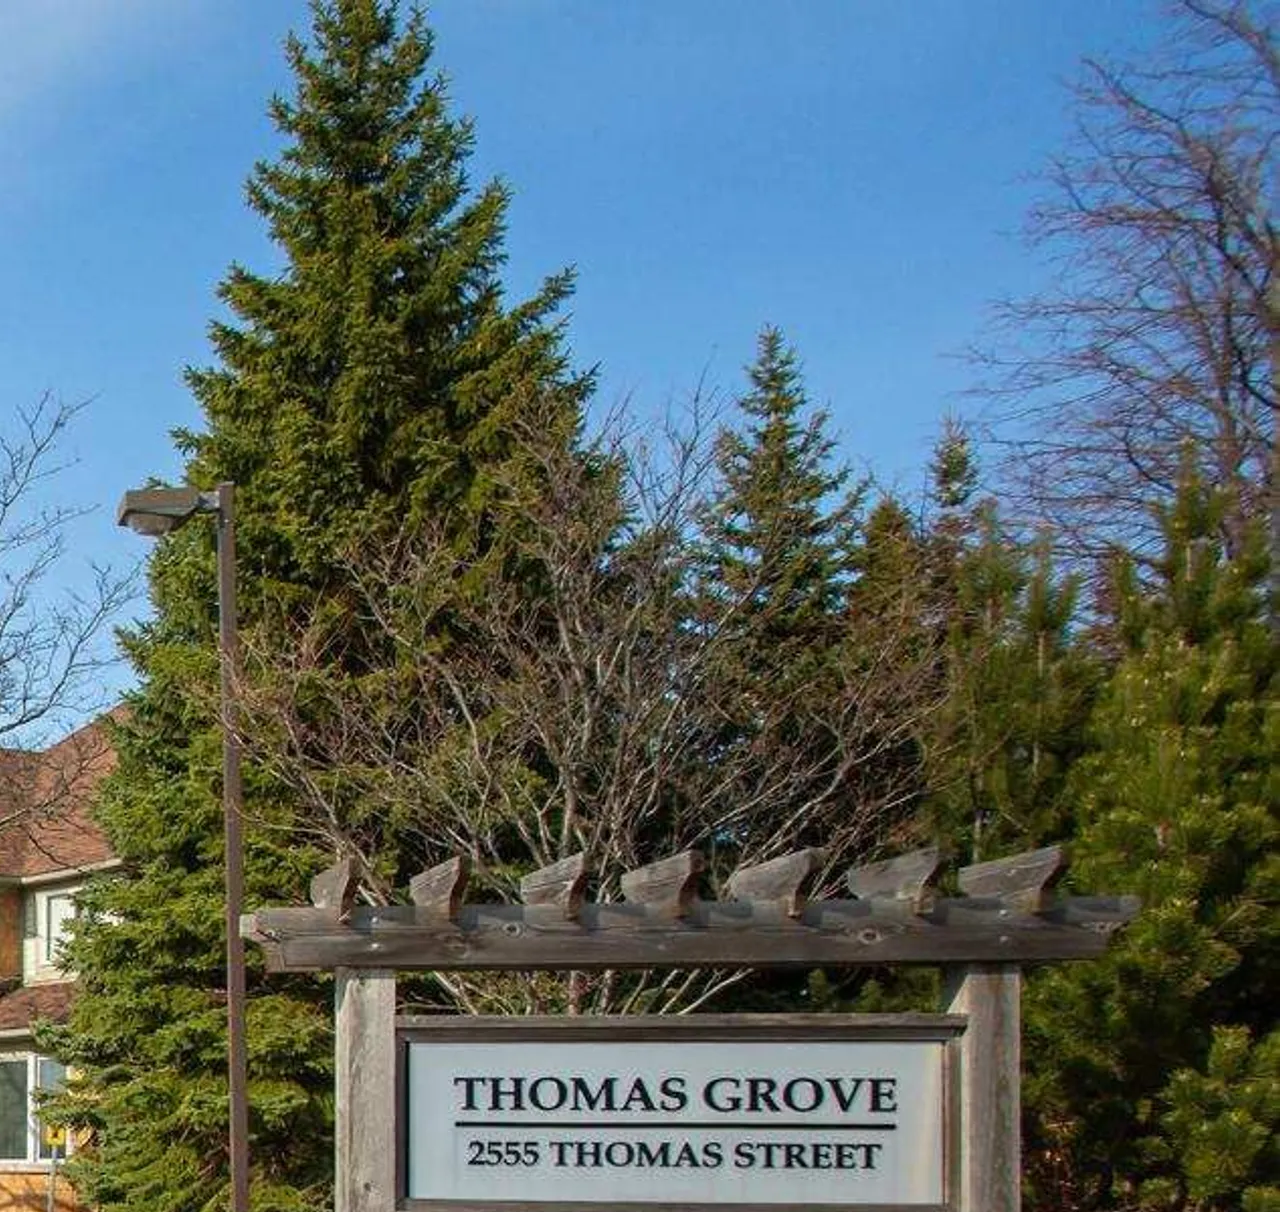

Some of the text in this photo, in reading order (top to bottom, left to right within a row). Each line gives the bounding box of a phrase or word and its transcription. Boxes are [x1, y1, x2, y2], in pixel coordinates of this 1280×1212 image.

[453, 1076, 897, 1113] THOMAS GROVE
[467, 1140, 882, 1170] 2555 THOMAS STREET
